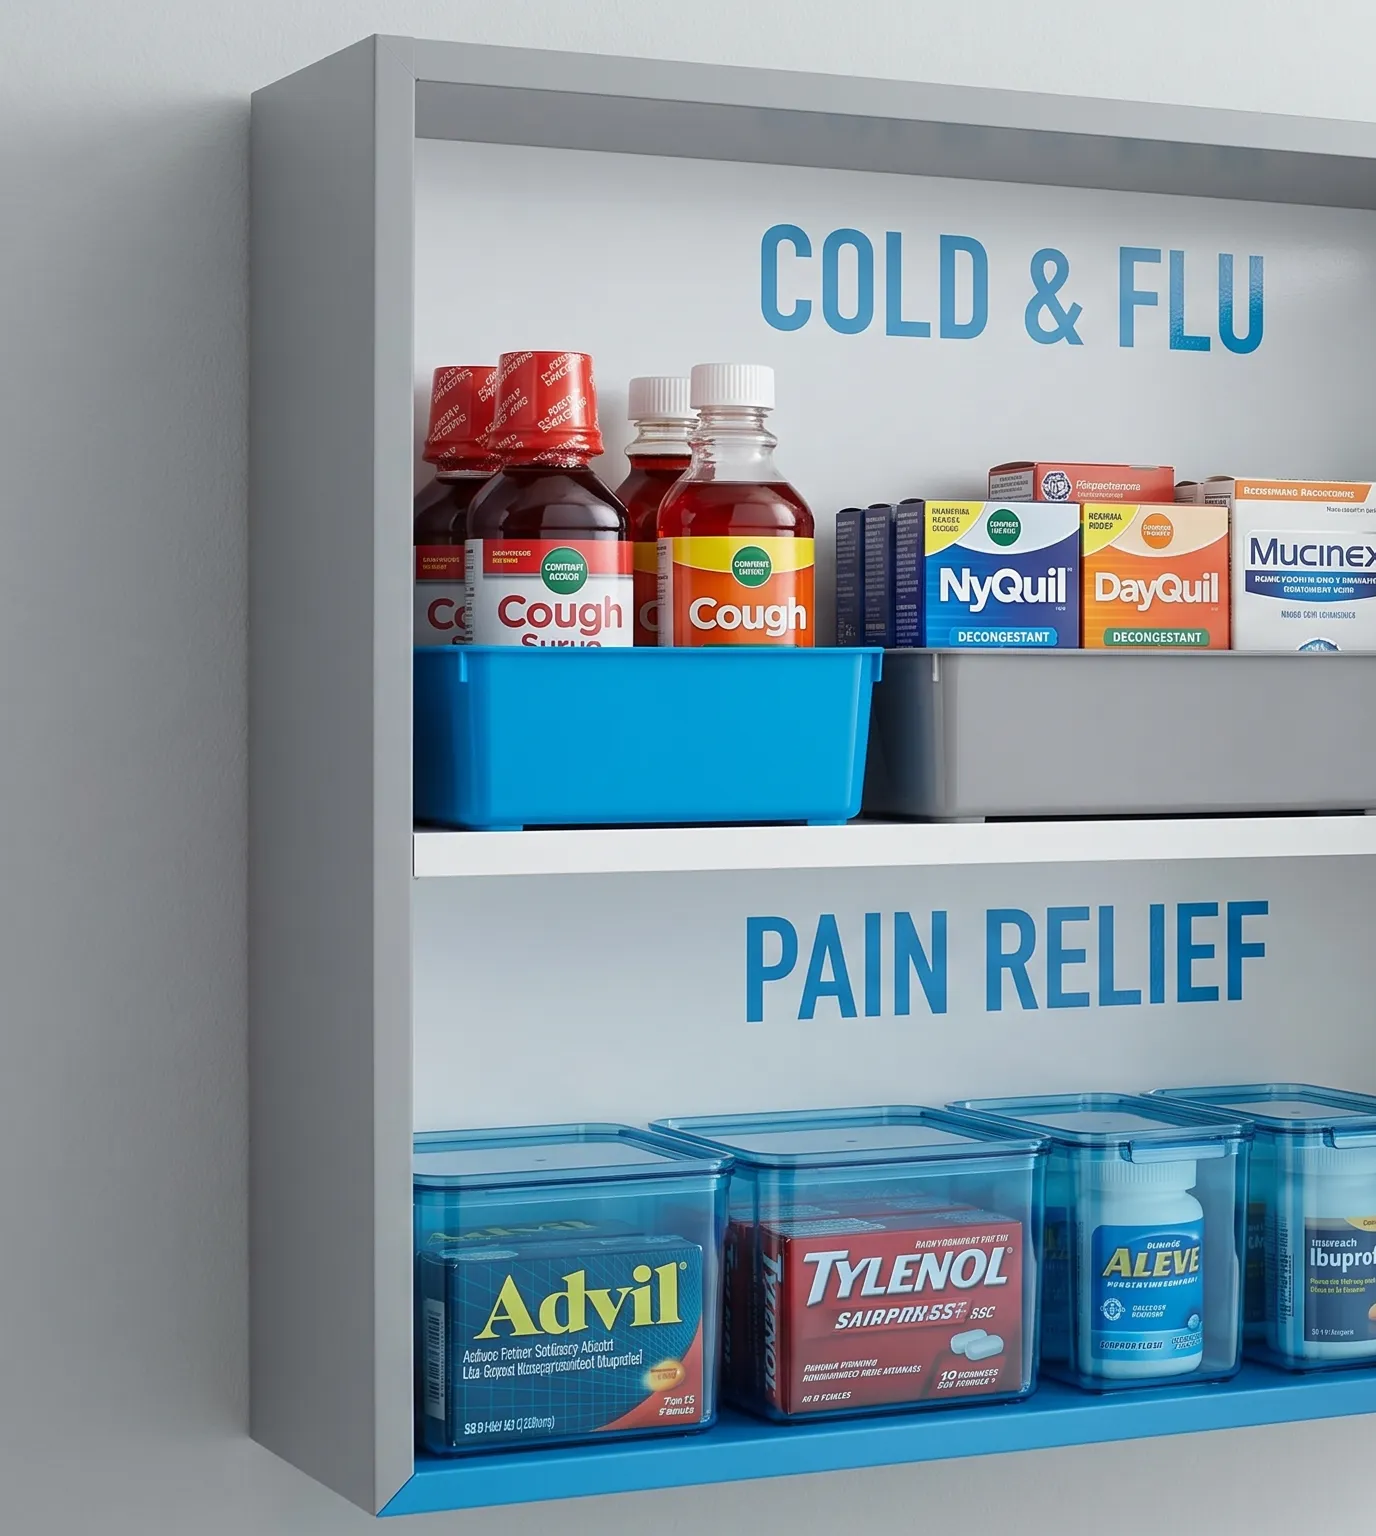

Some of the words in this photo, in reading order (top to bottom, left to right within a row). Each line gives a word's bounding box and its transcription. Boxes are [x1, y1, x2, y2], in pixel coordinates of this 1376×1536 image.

[761, 223, 989, 340] COLD
[1024, 247, 1084, 346] &
[1119, 246, 1265, 354] FLU
[939, 567, 1066, 613] NyQuil
[1095, 572, 1219, 612] DayQuil
[497, 594, 623, 636] Cough
[689, 596, 807, 637] Cough
[957, 631, 1050, 643] DECONGESTANT
[1112, 632, 1202, 644] DECONGESTANT
[746, 910, 947, 1023] PAIN
[986, 900, 1269, 1012] RELIEF
[803, 1246, 1008, 1307] TYLENOL
[1102, 1246, 1200, 1277] ALEVE
[941, 1370, 957, 1381] 10
